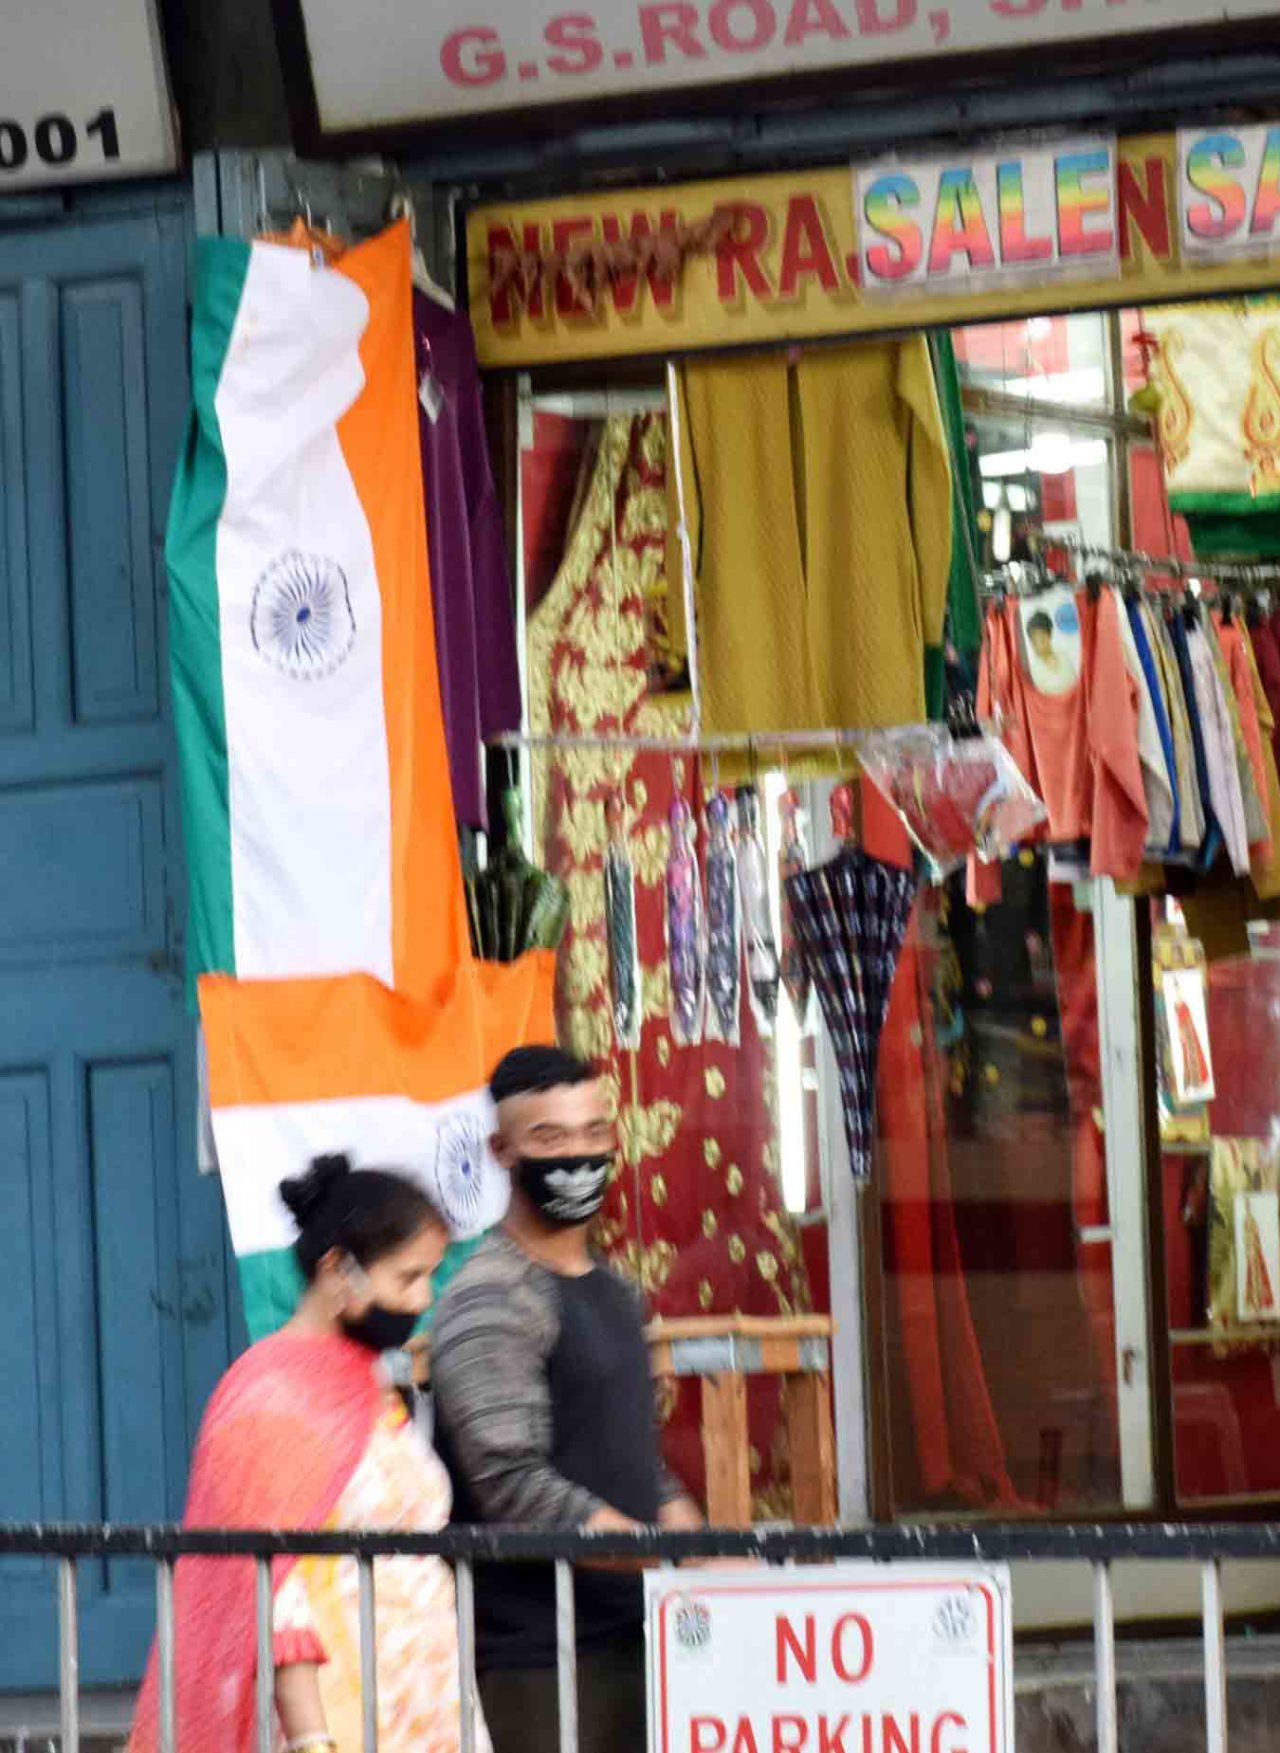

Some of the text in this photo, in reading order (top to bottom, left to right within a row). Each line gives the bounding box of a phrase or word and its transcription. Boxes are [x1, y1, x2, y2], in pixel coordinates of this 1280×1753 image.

[863, 151, 1114, 281] SALE
[488, 210, 678, 326] NEW
[775, 1611, 874, 1684] NO
[689, 1711, 969, 1753] PARKING
